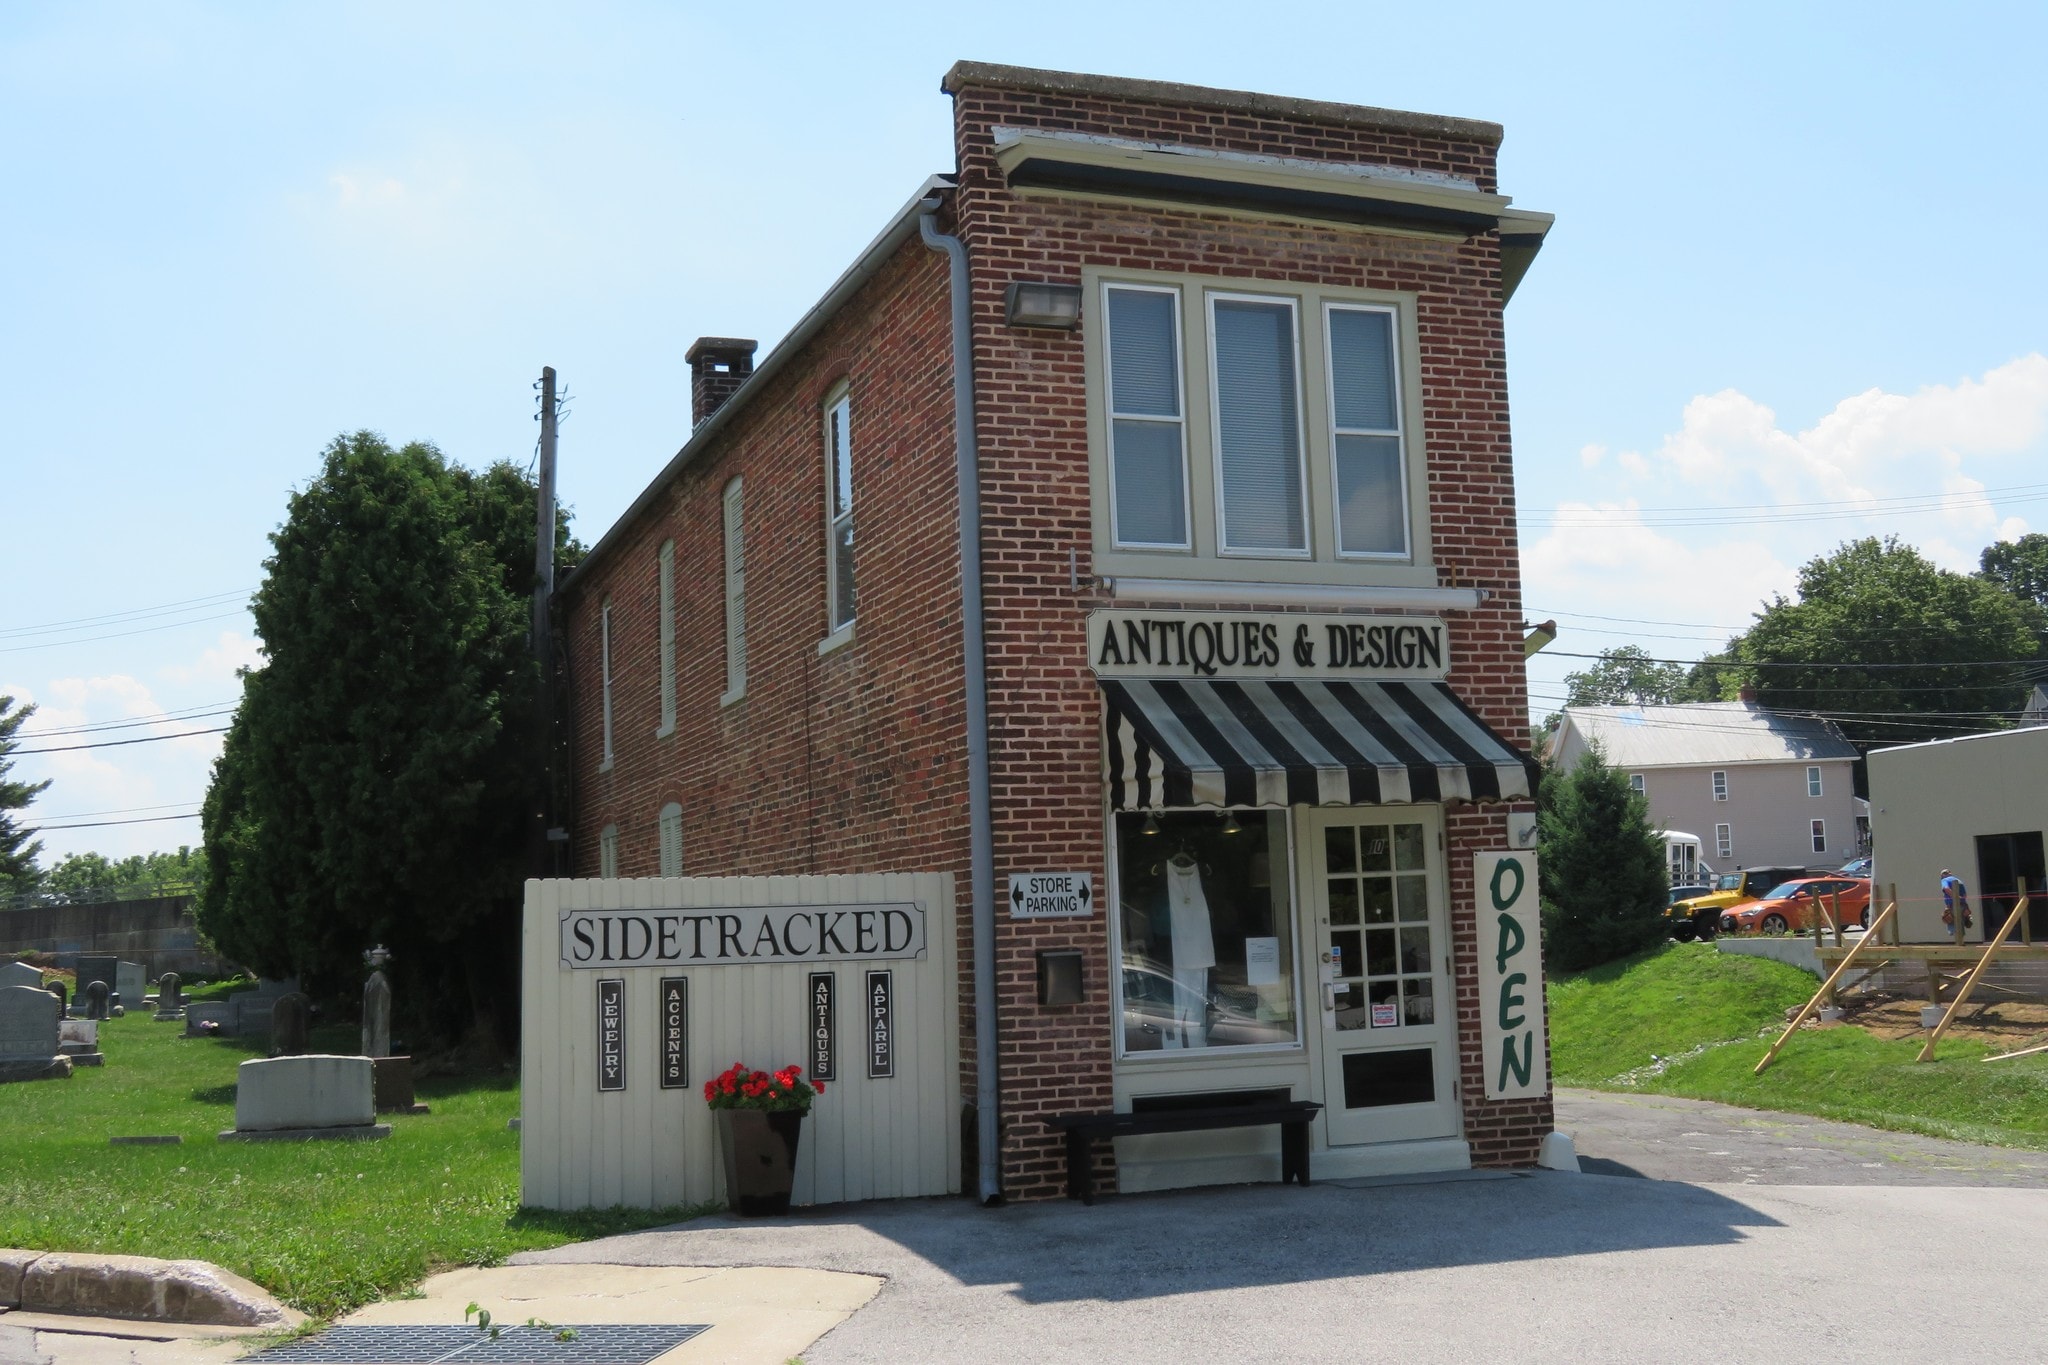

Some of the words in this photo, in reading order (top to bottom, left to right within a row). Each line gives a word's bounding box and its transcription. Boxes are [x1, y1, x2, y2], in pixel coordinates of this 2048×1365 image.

[1098, 619, 1280, 675] ANTIQUES
[1293, 623, 1316, 668] &
[1325, 624, 1442, 669] DESIGN
[1026, 895, 1078, 913] PARKING
[1030, 877, 1072, 894] STORE
[572, 909, 914, 962] SIDETRACKED
[1489, 857, 1533, 1093] OPEN
[605, 993, 619, 1078] JEWELRY
[668, 989, 681, 1078] ACCENTS
[816, 982, 829, 1073] ANTIQUES
[874, 983, 887, 1066] APPAREL
